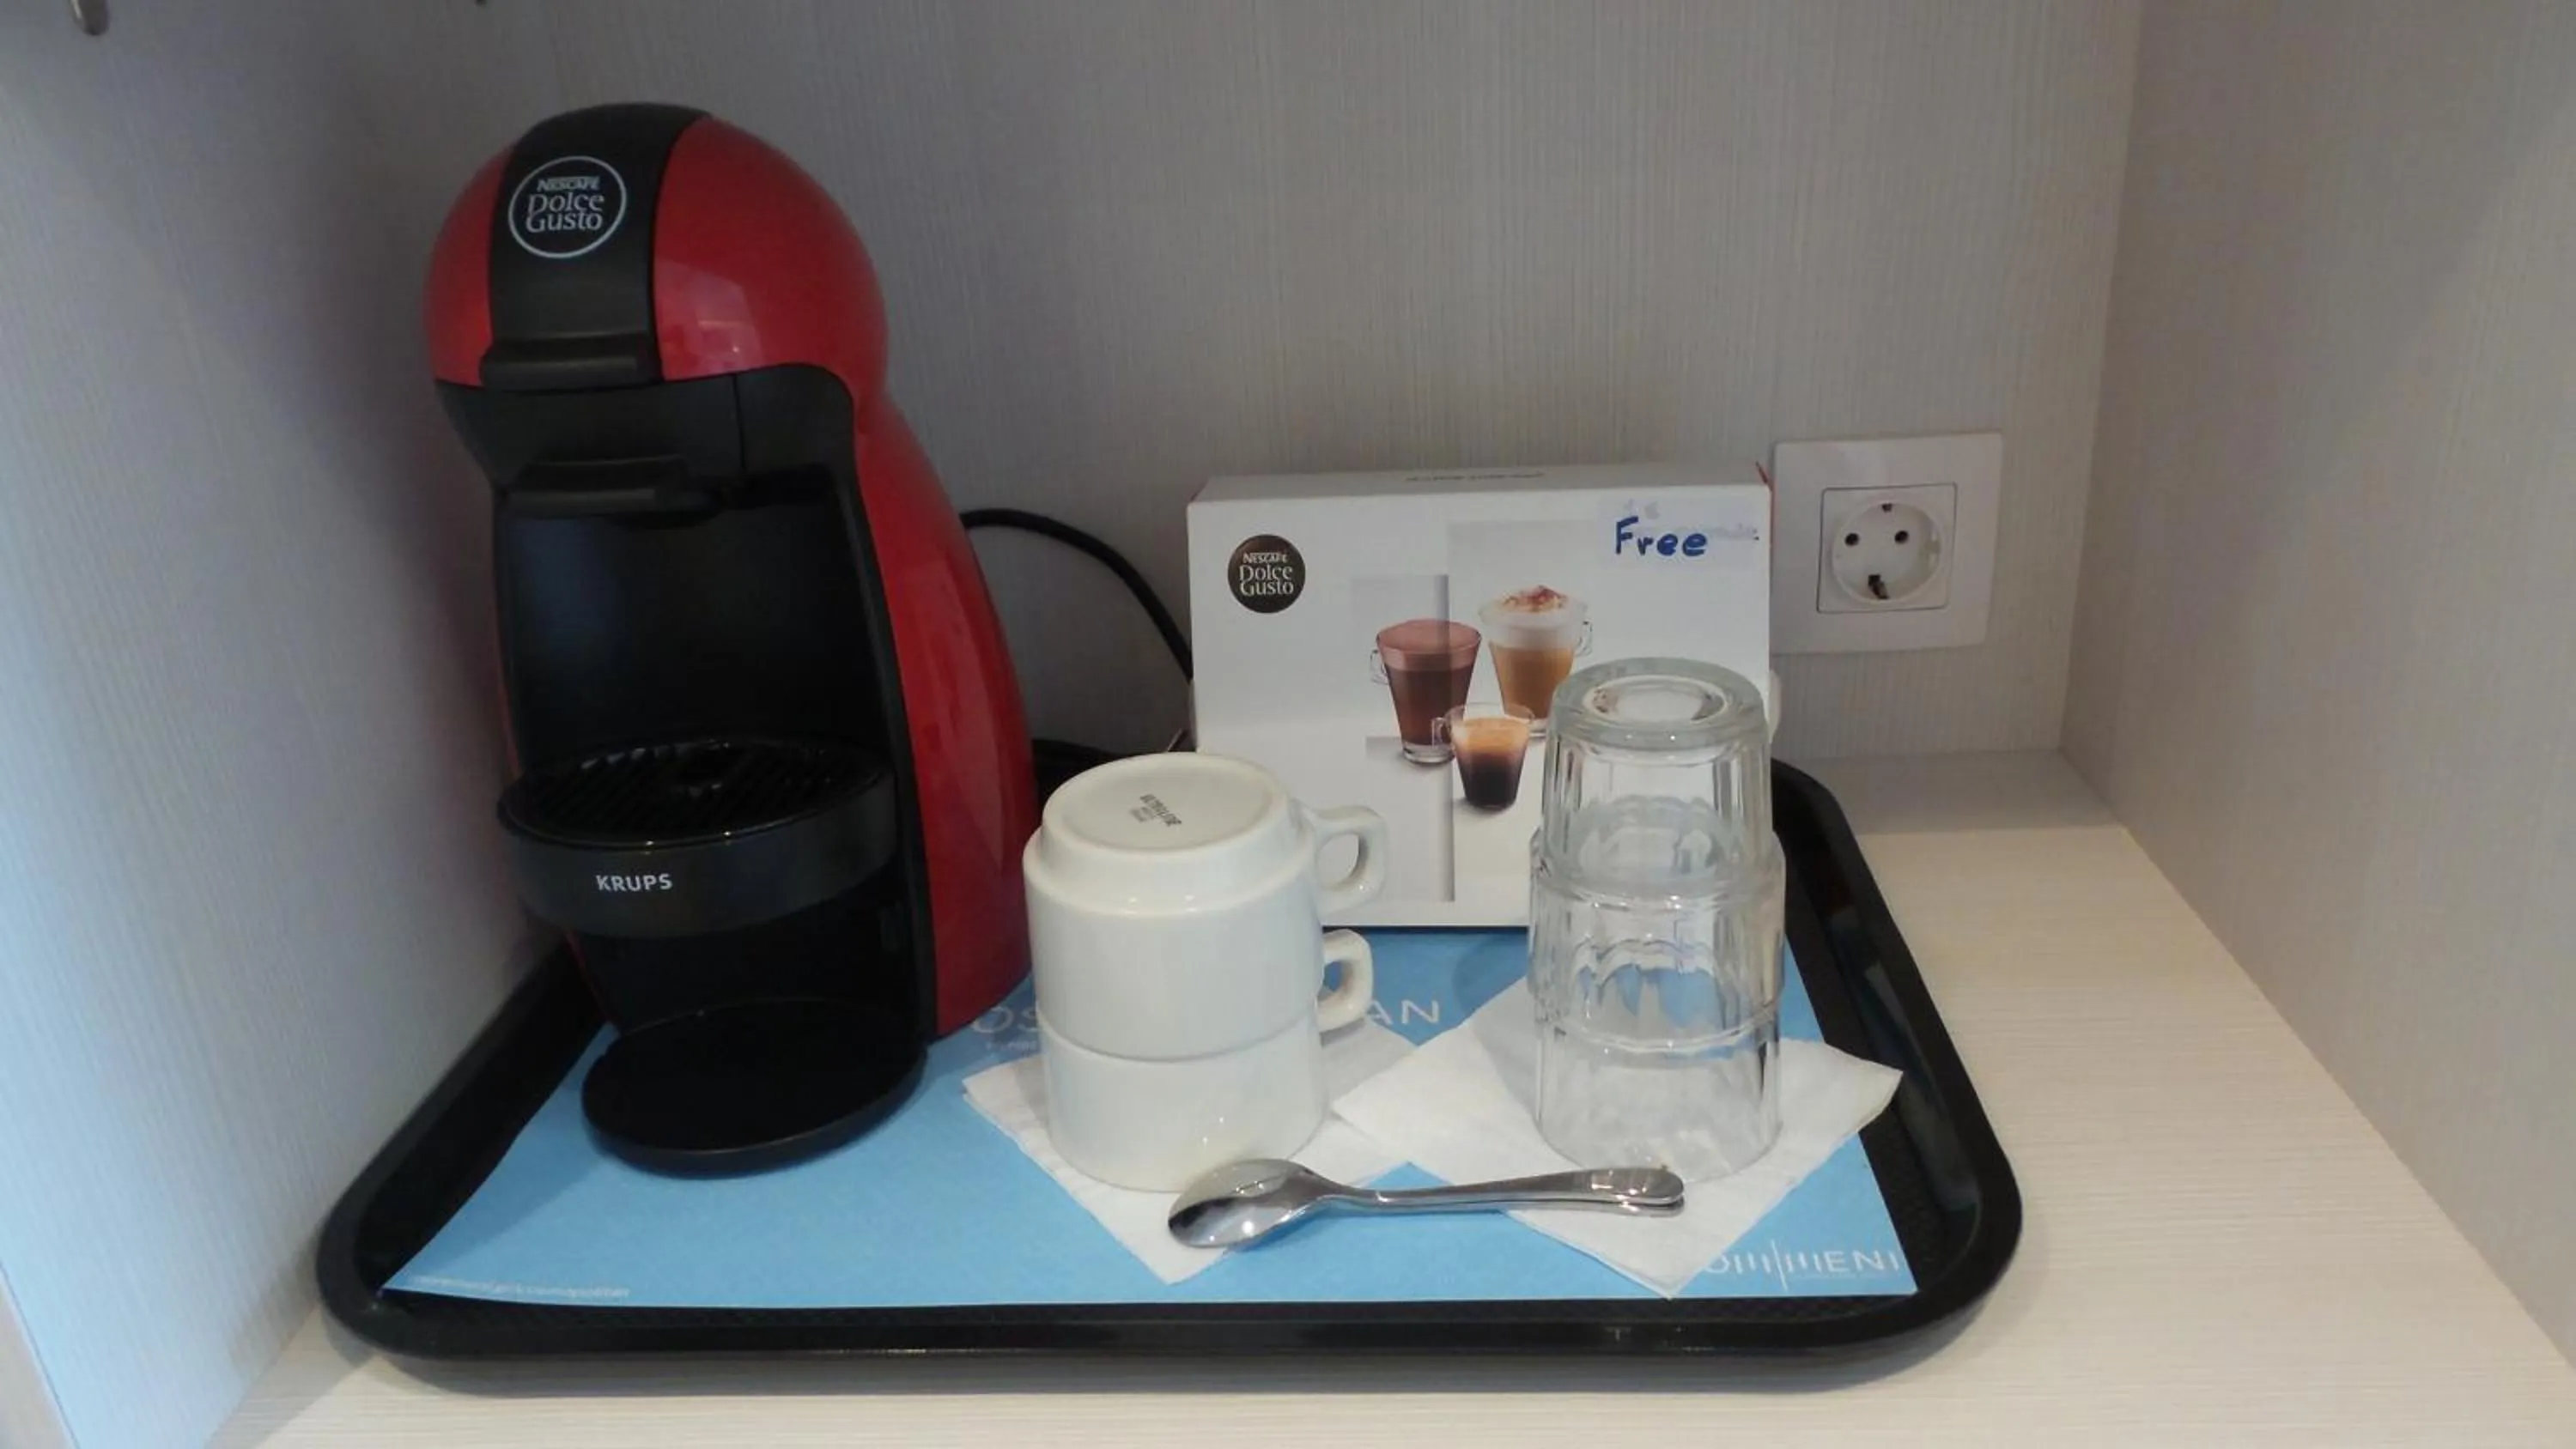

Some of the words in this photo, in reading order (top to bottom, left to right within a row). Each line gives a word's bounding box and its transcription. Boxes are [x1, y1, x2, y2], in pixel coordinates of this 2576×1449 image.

[528, 191, 605, 215] Dolce
[526, 209, 602, 233] Gusto
[1615, 515, 1707, 556] Free
[1239, 563, 1293, 582] Dolce
[1239, 579, 1294, 597] Gusto
[596, 873, 673, 892] KRUPS
